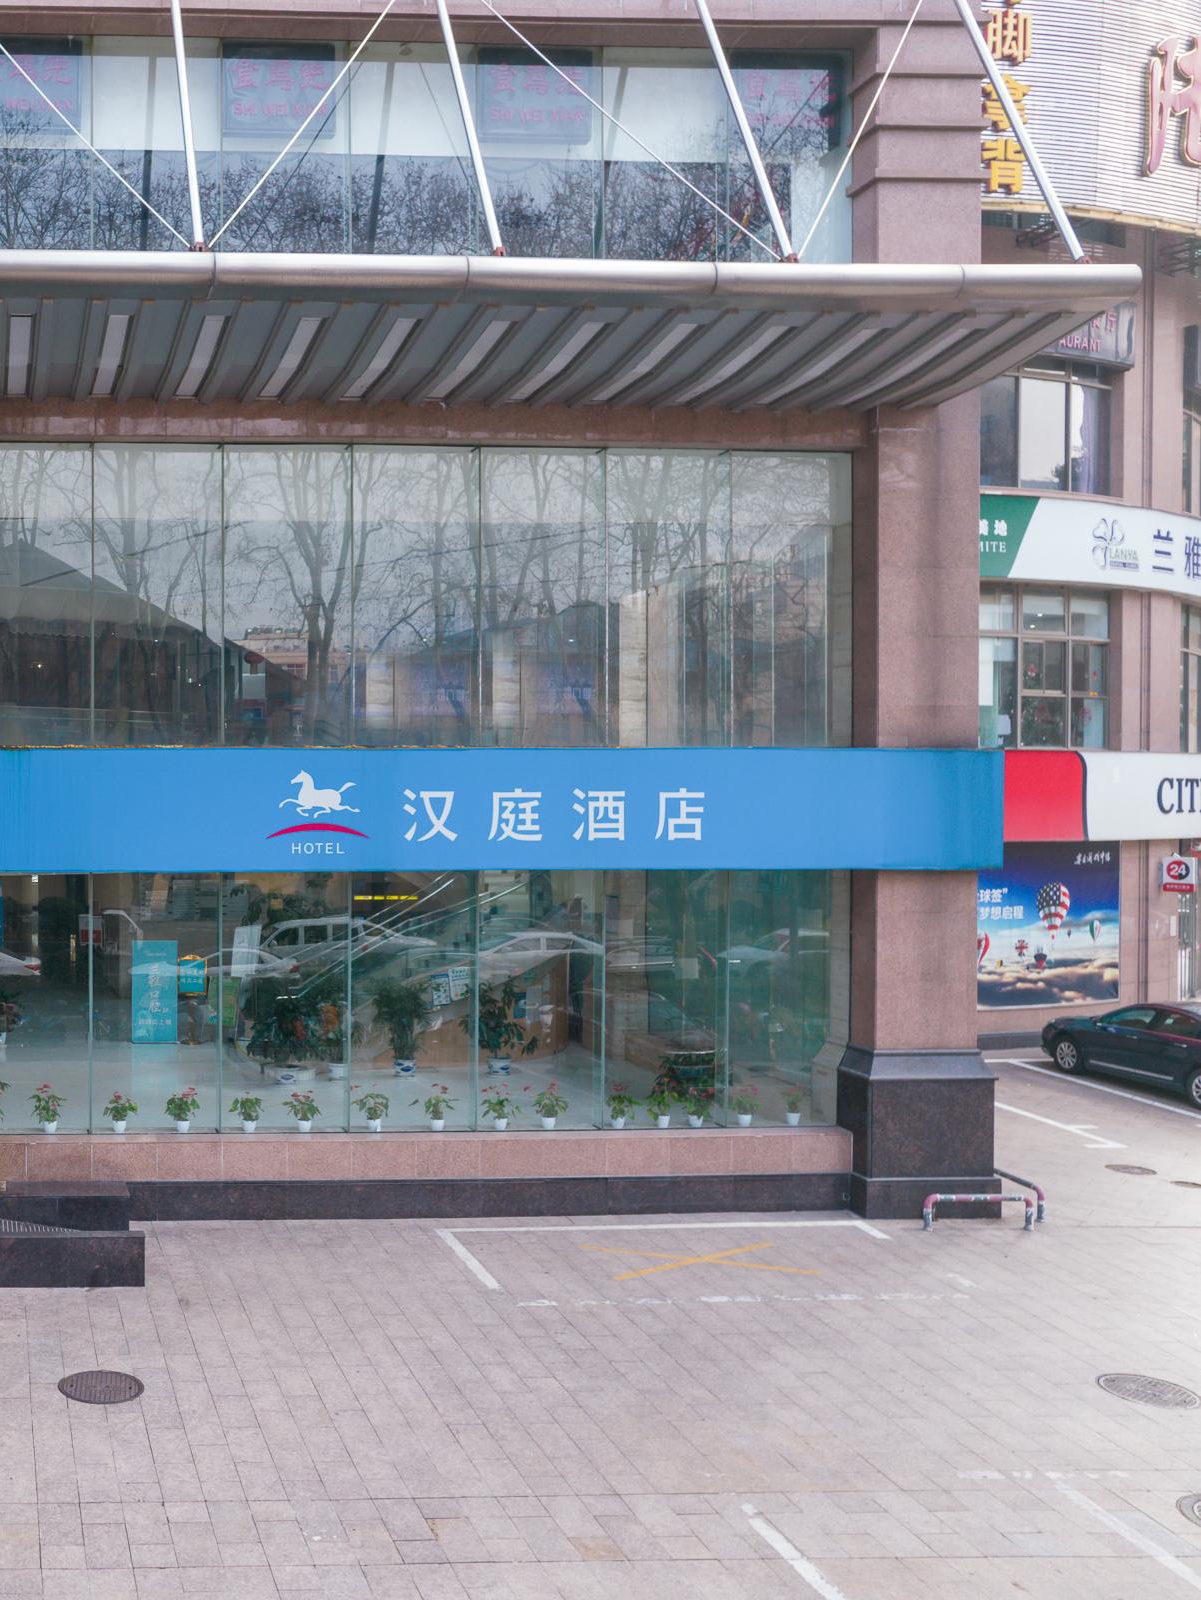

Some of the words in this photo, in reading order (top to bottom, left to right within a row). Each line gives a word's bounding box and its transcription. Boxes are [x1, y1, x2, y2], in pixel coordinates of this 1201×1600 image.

[981, 0, 1032, 194] 脚拿背
[1110, 547, 1139, 562] LANYA
[1157, 776, 1201, 815] CIT
[402, 787, 706, 843] 汉庭酒店
[291, 842, 345, 856] HOTEL
[1170, 864, 1188, 877] 24
[979, 905, 1024, 920] 梦想启程
